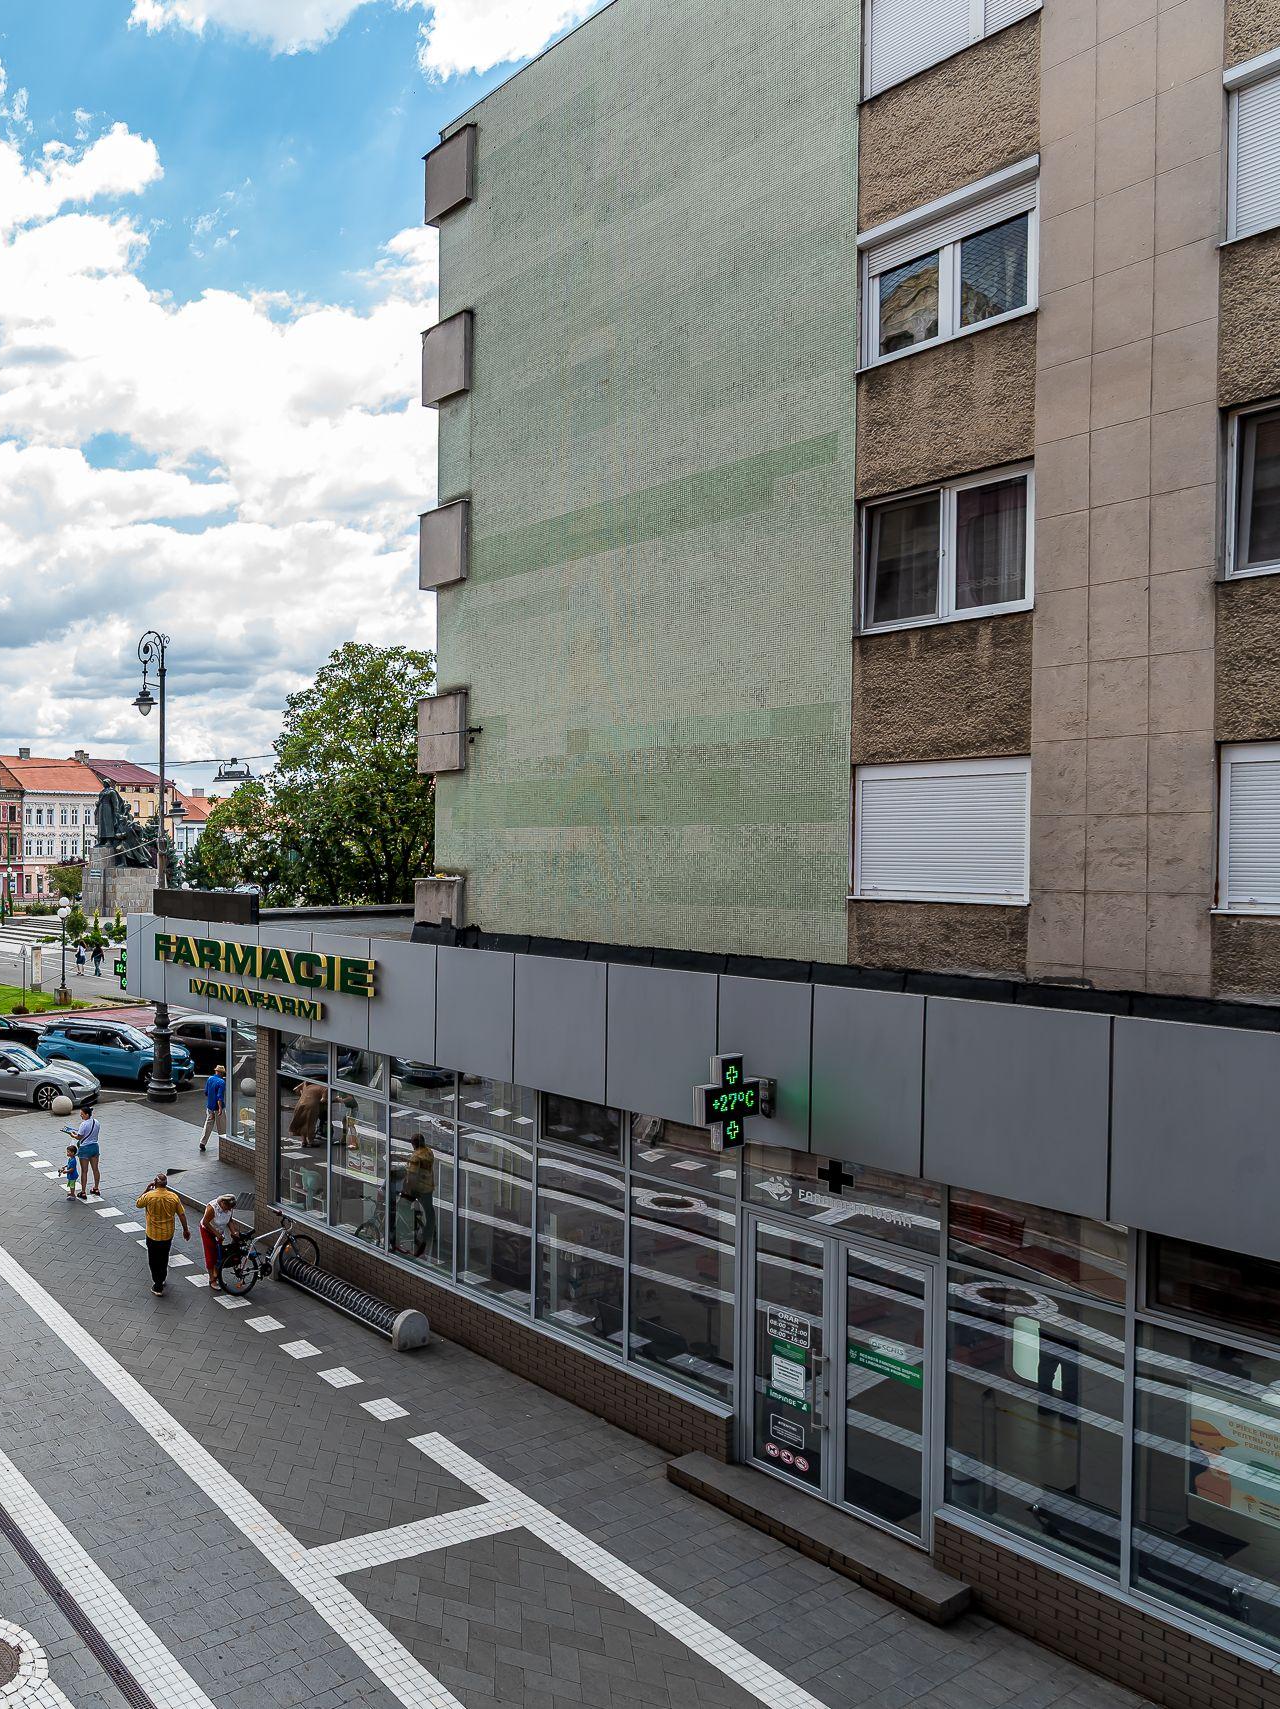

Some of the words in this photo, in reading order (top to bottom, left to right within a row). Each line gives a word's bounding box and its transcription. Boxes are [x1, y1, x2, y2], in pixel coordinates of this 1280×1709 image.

[154, 932, 376, 998] FARMACIE
[189, 978, 253, 1006] IVONA
[253, 990, 322, 1021] FARM
[778, 1312, 799, 1324] ORAR
